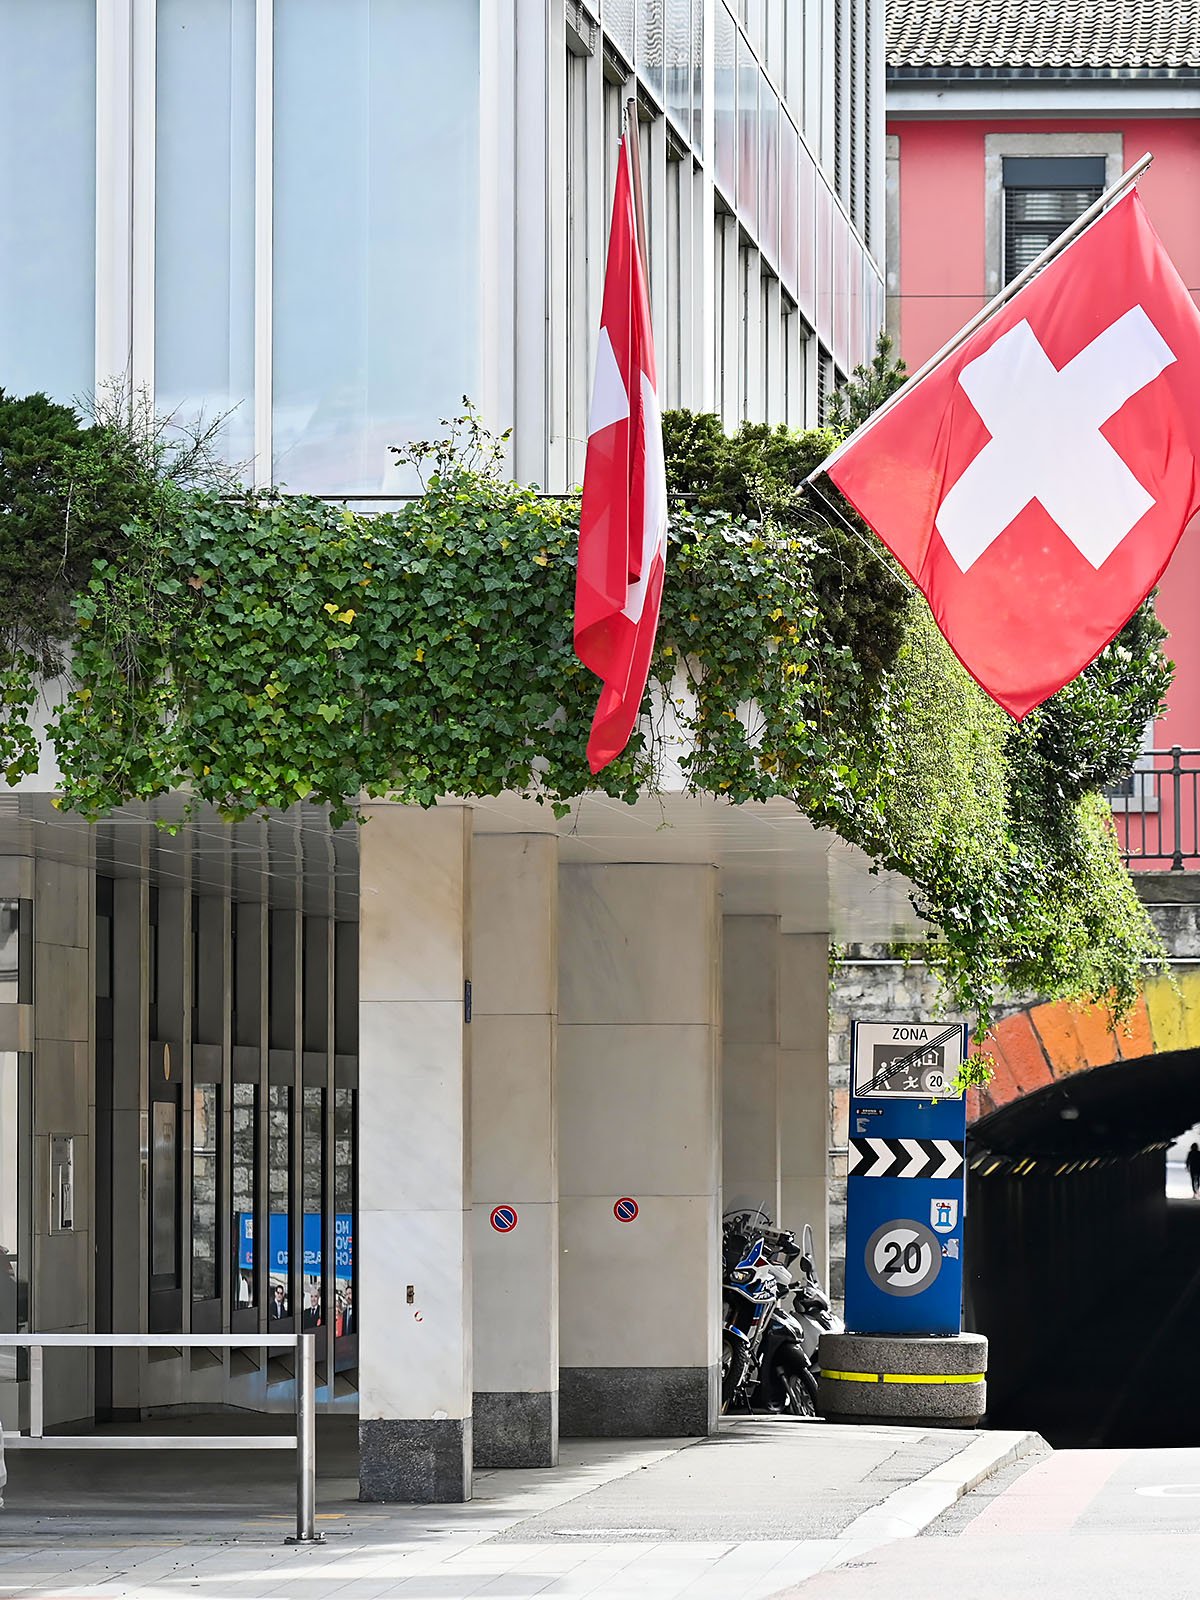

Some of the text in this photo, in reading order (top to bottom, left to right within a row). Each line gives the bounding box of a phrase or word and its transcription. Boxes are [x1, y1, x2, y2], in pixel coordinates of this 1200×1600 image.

[892, 1028, 928, 1040] ZONA
[929, 1076, 943, 1087] 20
[884, 1242, 921, 1274] 20
